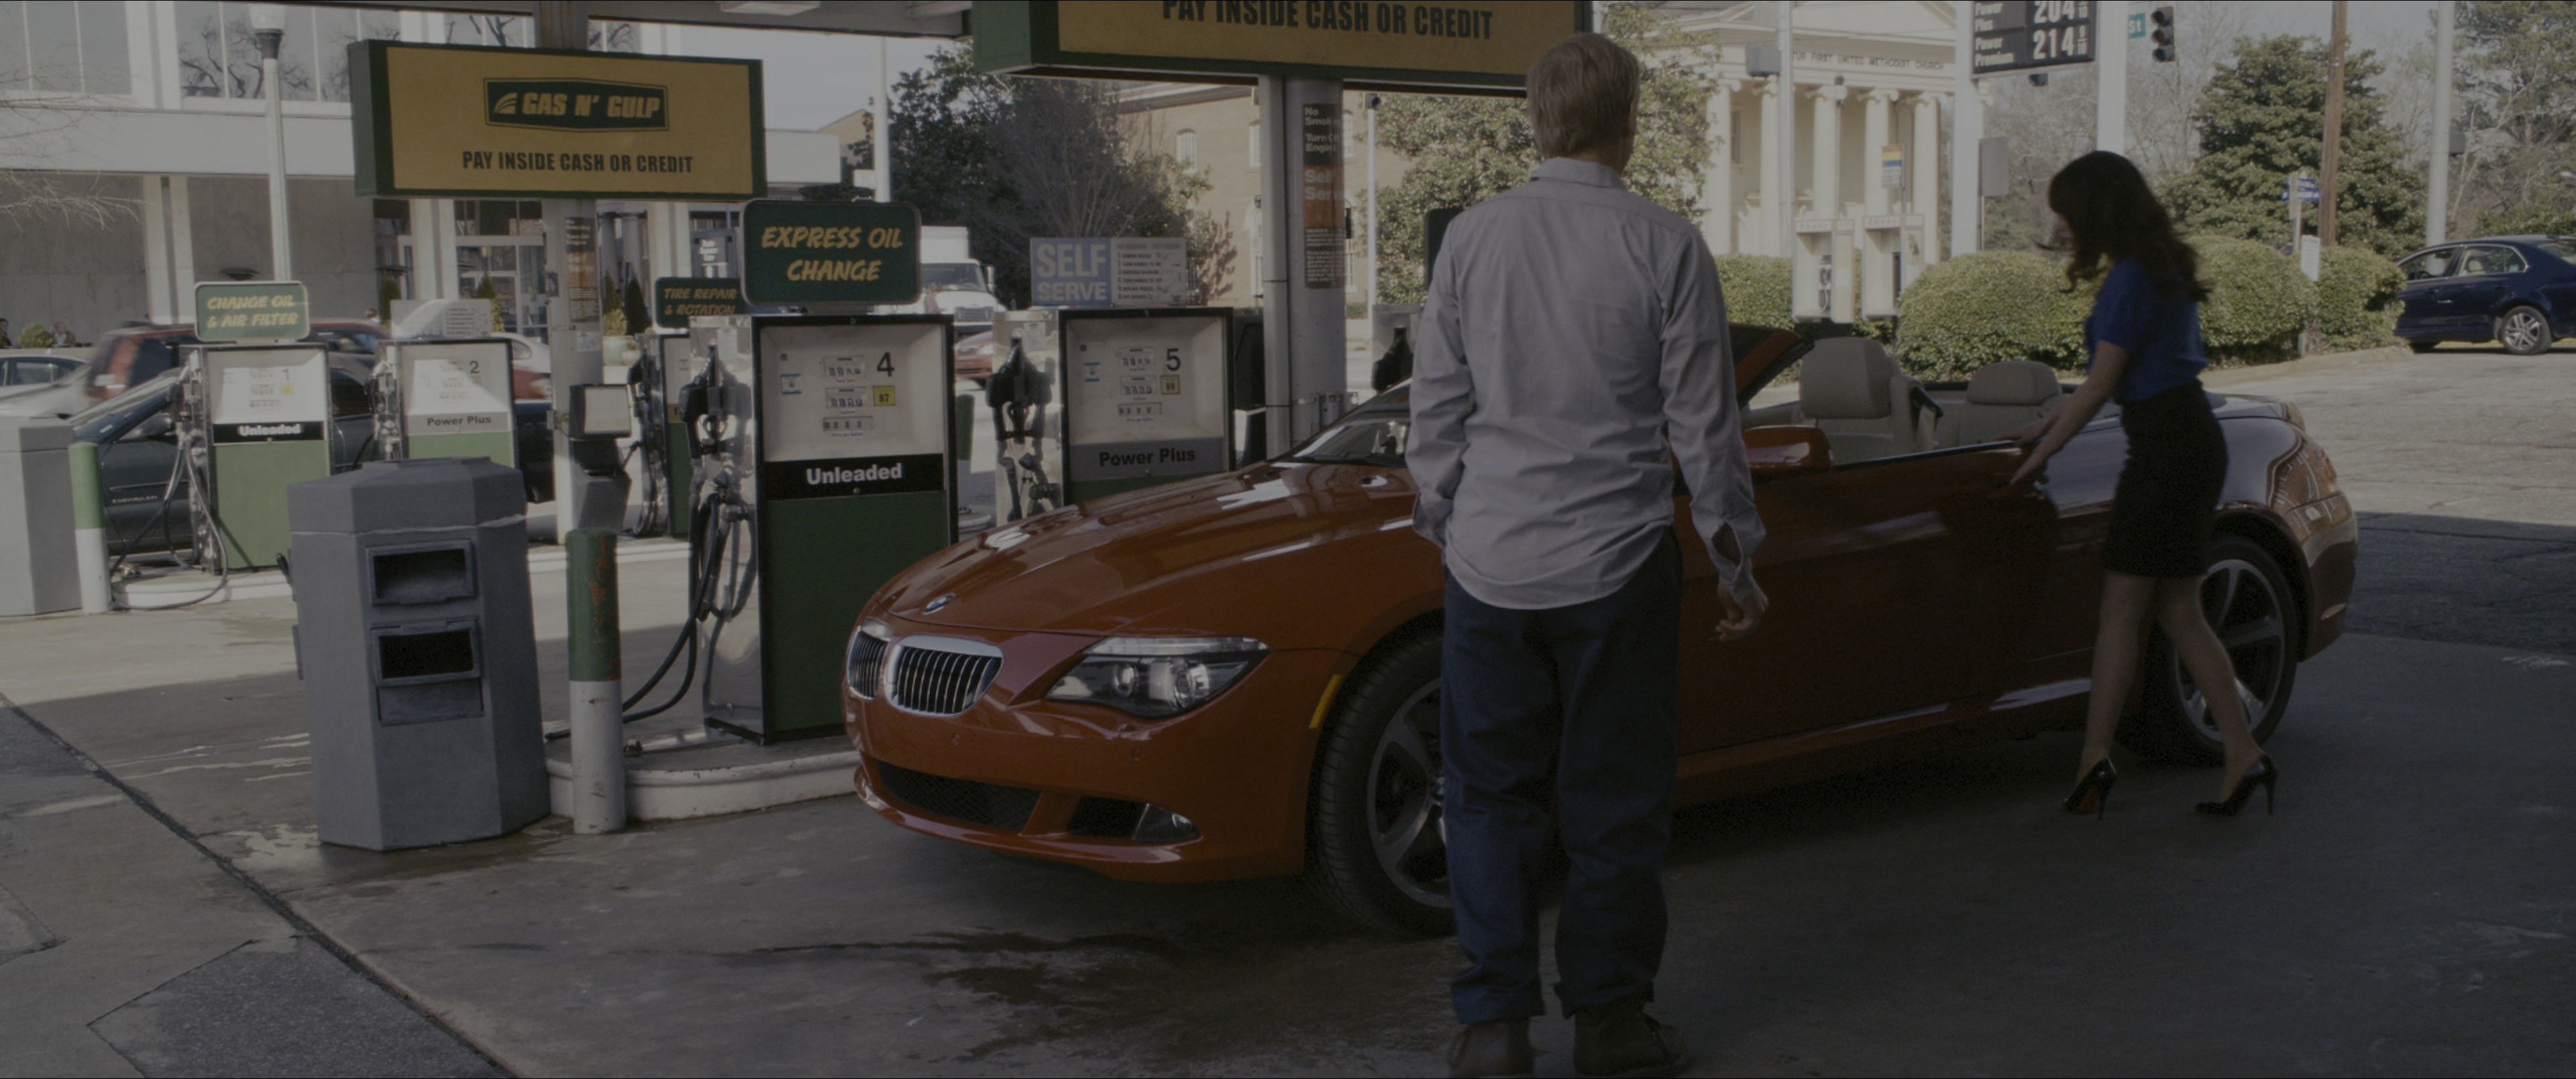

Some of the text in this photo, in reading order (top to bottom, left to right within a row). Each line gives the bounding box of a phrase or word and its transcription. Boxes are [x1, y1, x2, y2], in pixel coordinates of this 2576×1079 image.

[1163, 1, 1493, 40] PAY INSIDE CASH OR CREDIT
[1975, 2, 2003, 16] Power
[2034, 1, 2076, 23] 204
[1975, 18, 1993, 32] Plus
[1975, 36, 2003, 51] Power
[2033, 25, 2074, 60] 214
[1837, 54, 1864, 66] UNITED
[1870, 56, 1910, 69] METHODIST
[1915, 59, 1944, 71] CHURCH
[1975, 51, 2015, 66] Premium
[522, 92, 661, 119] GAS N' GULP
[1305, 107, 1319, 116] No
[1305, 133, 1327, 142] Turn
[463, 151, 693, 174] PAY INSIDE CASH OR CREDIT
[761, 225, 904, 250] EXPRESS OIL
[1036, 243, 1106, 278] SELF
[787, 258, 881, 282] CHANGE
[664, 288, 737, 299] TIRE REPAIR
[1036, 282, 1107, 301] SERVE
[207, 294, 296, 310] CHANGE OIL
[665, 304, 736, 315] & ROTATION
[206, 311, 299, 328] & AIR FILTER
[470, 360, 480, 374] 2
[877, 352, 895, 377] 4
[1166, 348, 1181, 372] 5
[281, 368, 290, 381] 1
[879, 393, 890, 403] 87
[427, 415, 492, 426] Power Plus
[238, 423, 301, 437] Unleaded
[1099, 448, 1196, 467] Power Plus
[806, 463, 903, 485] Unleaded
